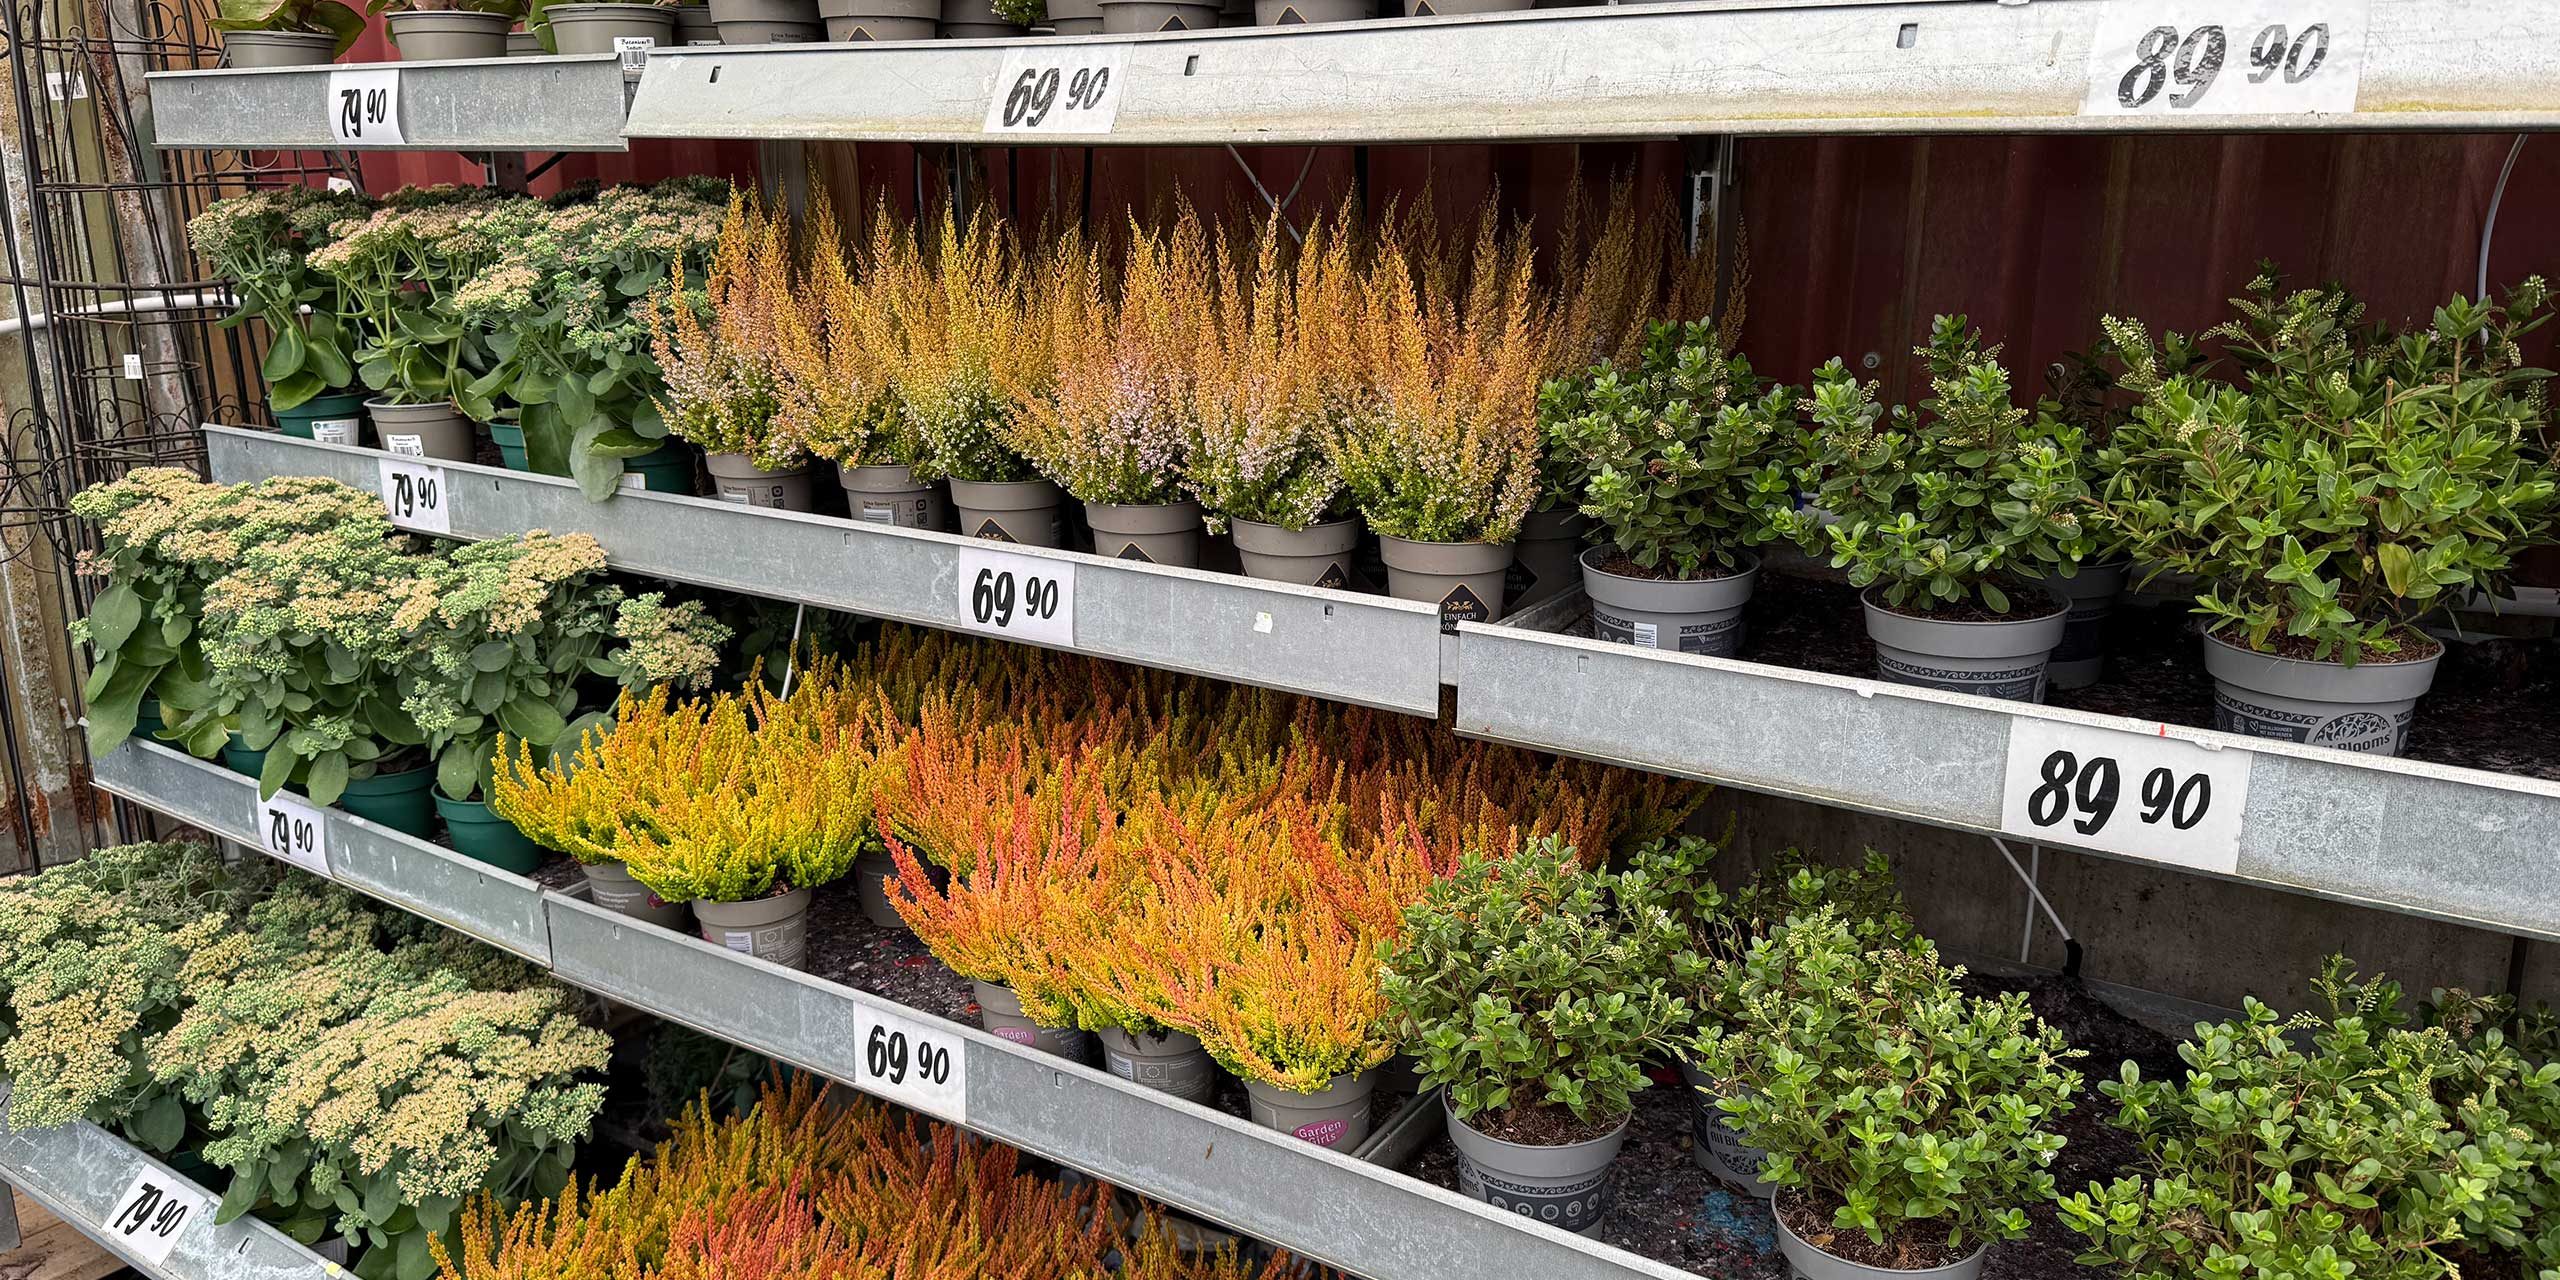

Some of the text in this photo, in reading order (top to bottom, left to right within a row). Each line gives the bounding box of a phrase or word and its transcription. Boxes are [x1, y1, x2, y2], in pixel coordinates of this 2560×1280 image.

[2117, 23, 2330, 109] 89 90
[341, 88, 387, 138] 79 90
[1003, 67, 1109, 127] 69 90
[391, 472, 437, 518] 79 90
[972, 567, 1059, 628] 69 90
[1444, 611, 1477, 621] EINFACH
[2027, 750, 2211, 836] 89 90
[268, 808, 313, 855] 79 90
[867, 1024, 950, 1085] 69 90
[1299, 1121, 1341, 1138] Garden
[1309, 1133, 1336, 1145] Girls
[113, 1182, 188, 1238] 79 90
